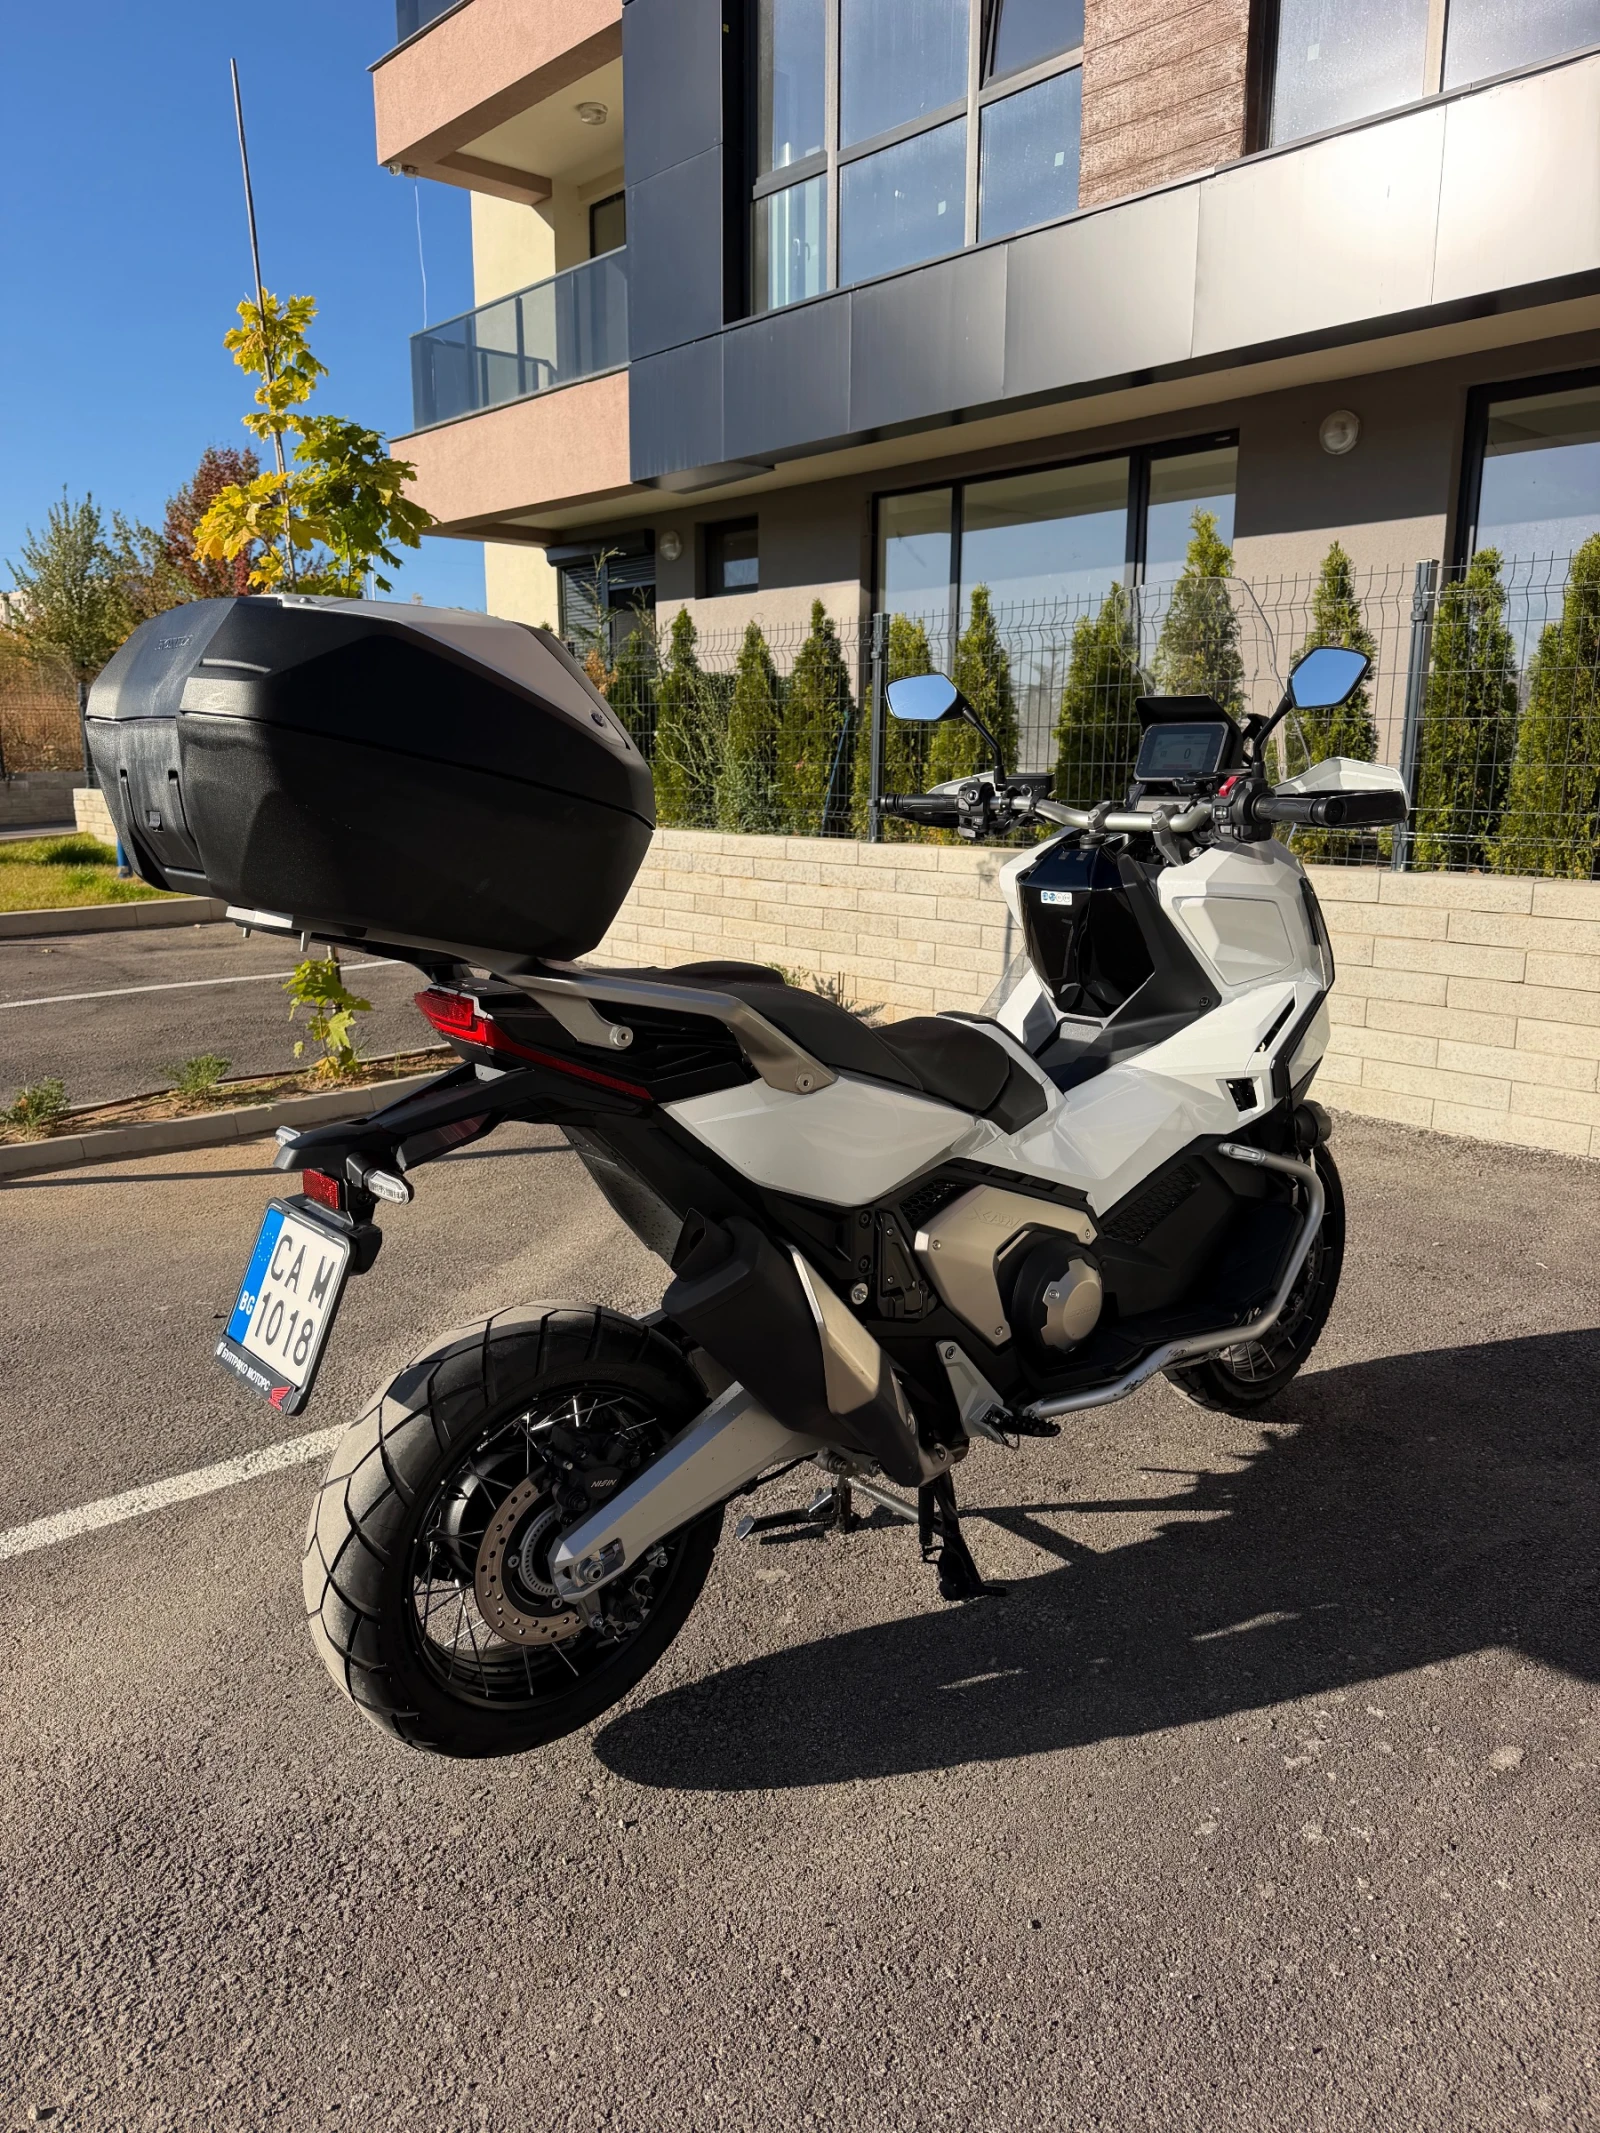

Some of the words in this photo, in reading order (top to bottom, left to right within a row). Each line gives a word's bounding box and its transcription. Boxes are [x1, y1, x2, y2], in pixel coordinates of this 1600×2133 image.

[239, 1290, 256, 1315] BG
[270, 1234, 307, 1294] CA
[308, 1256, 336, 1310] M
[255, 1291, 314, 1367] 1018
